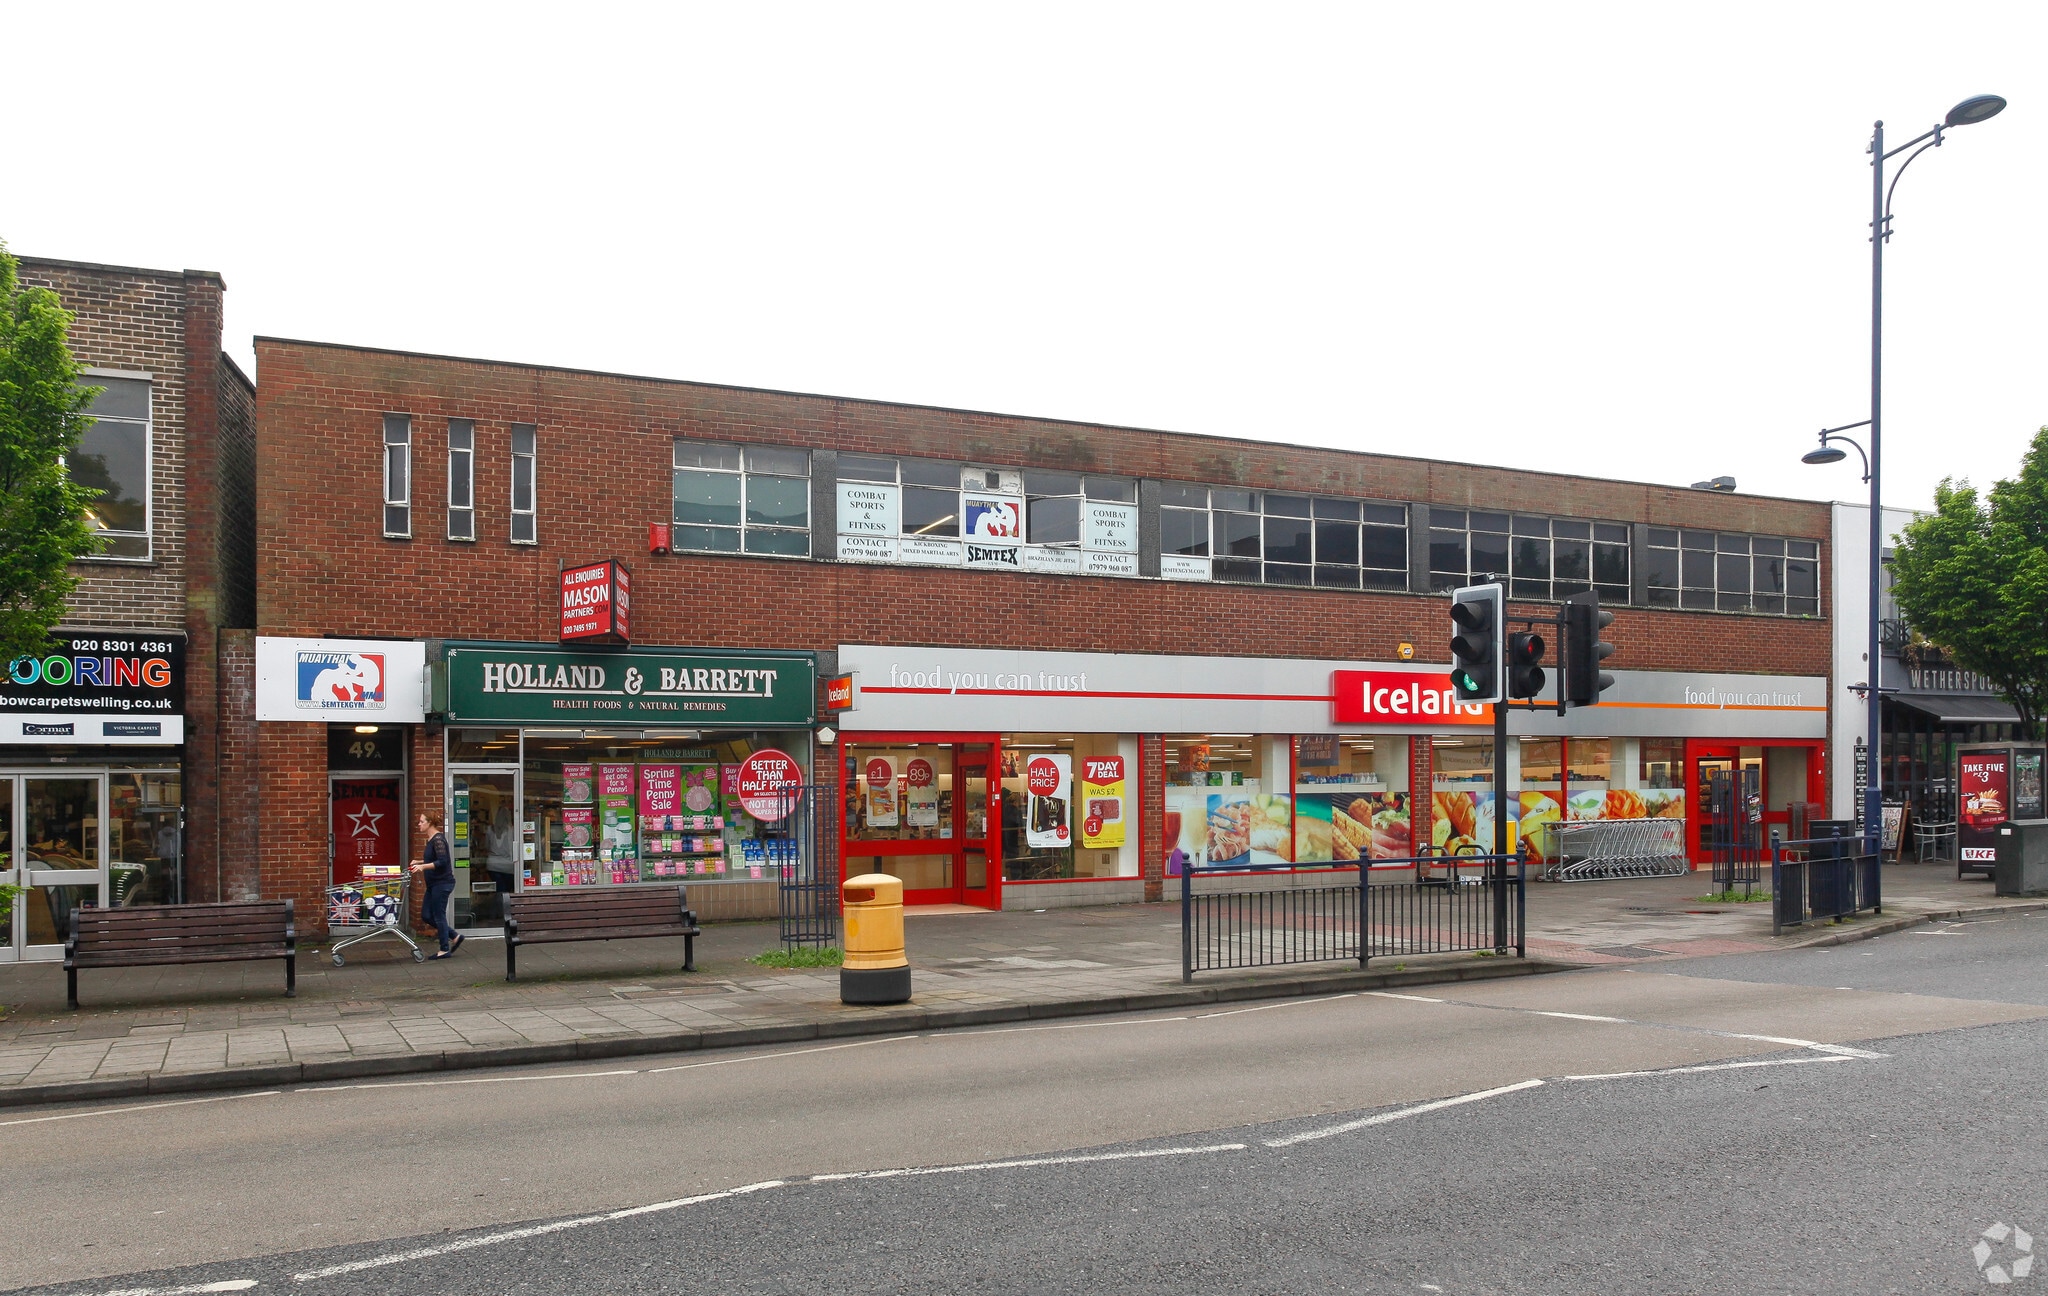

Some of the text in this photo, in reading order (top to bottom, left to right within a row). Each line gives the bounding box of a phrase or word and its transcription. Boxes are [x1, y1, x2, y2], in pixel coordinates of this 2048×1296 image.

[847, 490, 887, 500] COMBAT
[850, 501, 885, 510] SPORTS
[1093, 509, 1128, 519] COMBAT
[849, 521, 886, 530] FITNESS
[1095, 519, 1126, 528] SPORTS
[846, 538, 888, 547] CONTACT
[1094, 538, 1127, 547] FITNESS
[842, 548, 892, 558] 07979 960 087
[968, 545, 1018, 566] SEMTEX
[1092, 553, 1128, 563] CONTACT
[1088, 563, 1132, 573] 07979 960 087
[564, 573, 575, 585] ALL
[575, 567, 604, 584] ENQUIRIES
[564, 584, 609, 608] MASON
[564, 604, 608, 619] PARTNERS.COM
[563, 625, 573, 634] 020
[586, 622, 597, 631] 1971
[72, 640, 173, 653] 020 8301 4361
[298, 653, 350, 664] MUAYTHAI
[1, 655, 171, 688] OORING
[482, 663, 778, 698] HOLLAND & BARRETT
[889, 663, 1088, 695] food you can trust
[361, 691, 384, 700] MMA
[828, 685, 849, 702] Iceland
[1684, 685, 1802, 710] food you can trust
[552, 700, 727, 711] HEALTH FOODS & NATURAL REMEDIES
[644, 749, 712, 758] HOLLAND & BARRETT
[751, 760, 788, 770] BETTER
[1086, 761, 1119, 779] 7 DAY
[1963, 763, 2004, 773] TAKE FIVE
[643, 768, 675, 780] Spring
[755, 771, 784, 780] THAN
[870, 766, 884, 779] £1
[909, 768, 930, 781] 89p
[1030, 767, 1056, 778] HALF
[1097, 770, 1119, 779] DEAL
[647, 779, 673, 790] Time
[742, 780, 768, 791] HALF
[769, 780, 797, 791] PRICE
[1030, 778, 1056, 788] PRICE
[332, 780, 400, 800] SEMTEX
[646, 790, 675, 801] Penny
[651, 799, 672, 810] Sale
[748, 799, 767, 809] NOT
[1088, 821, 1098, 833] £1
[1975, 850, 1996, 859] KF
